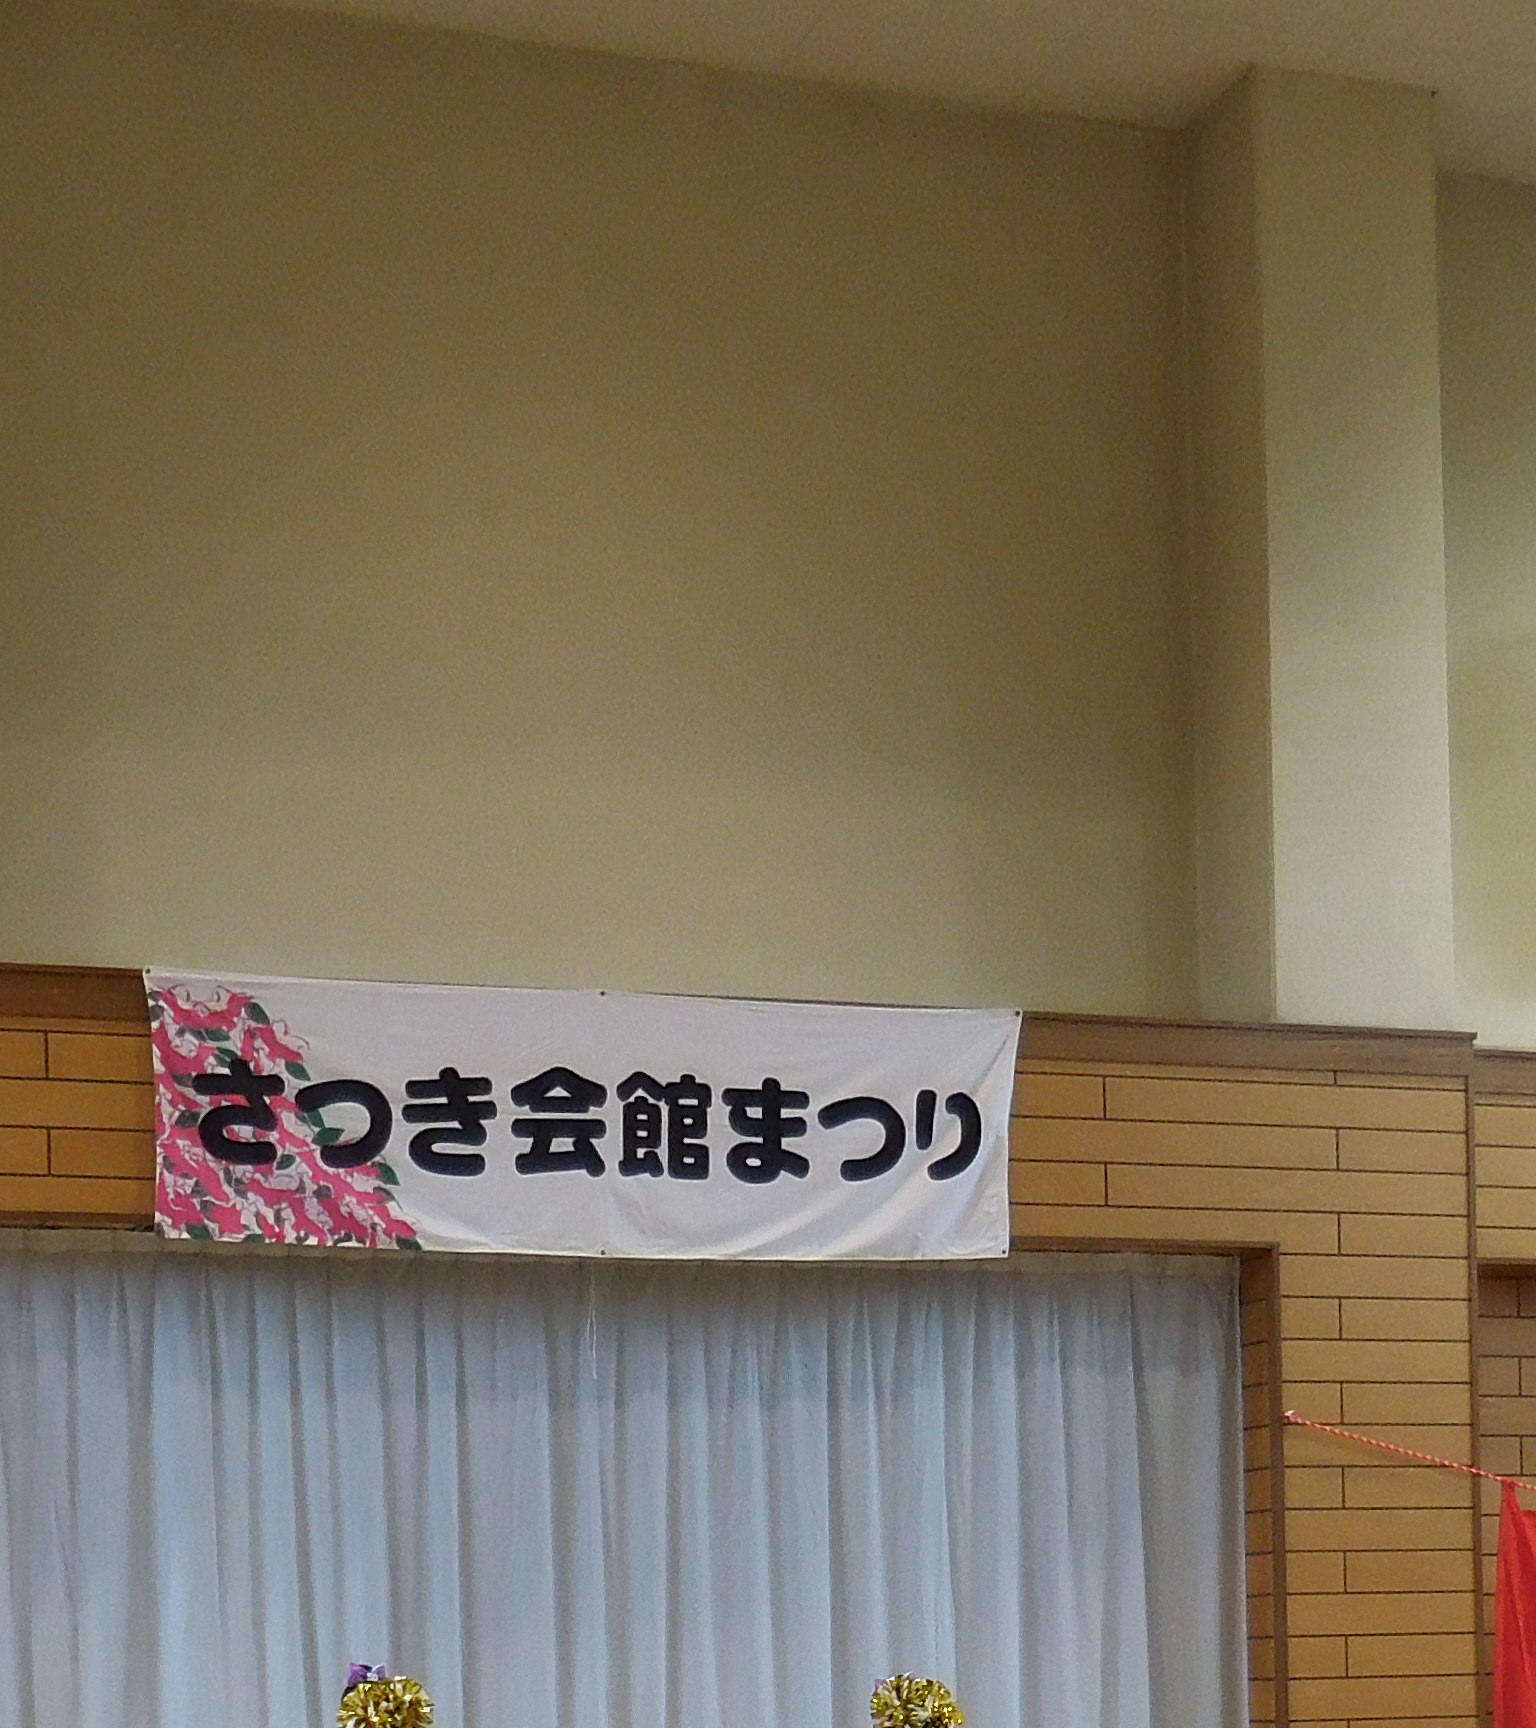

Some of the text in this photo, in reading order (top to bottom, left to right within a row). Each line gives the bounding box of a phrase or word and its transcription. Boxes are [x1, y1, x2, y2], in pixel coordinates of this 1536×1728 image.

[192, 1058, 982, 1185] さつき会館まつり
